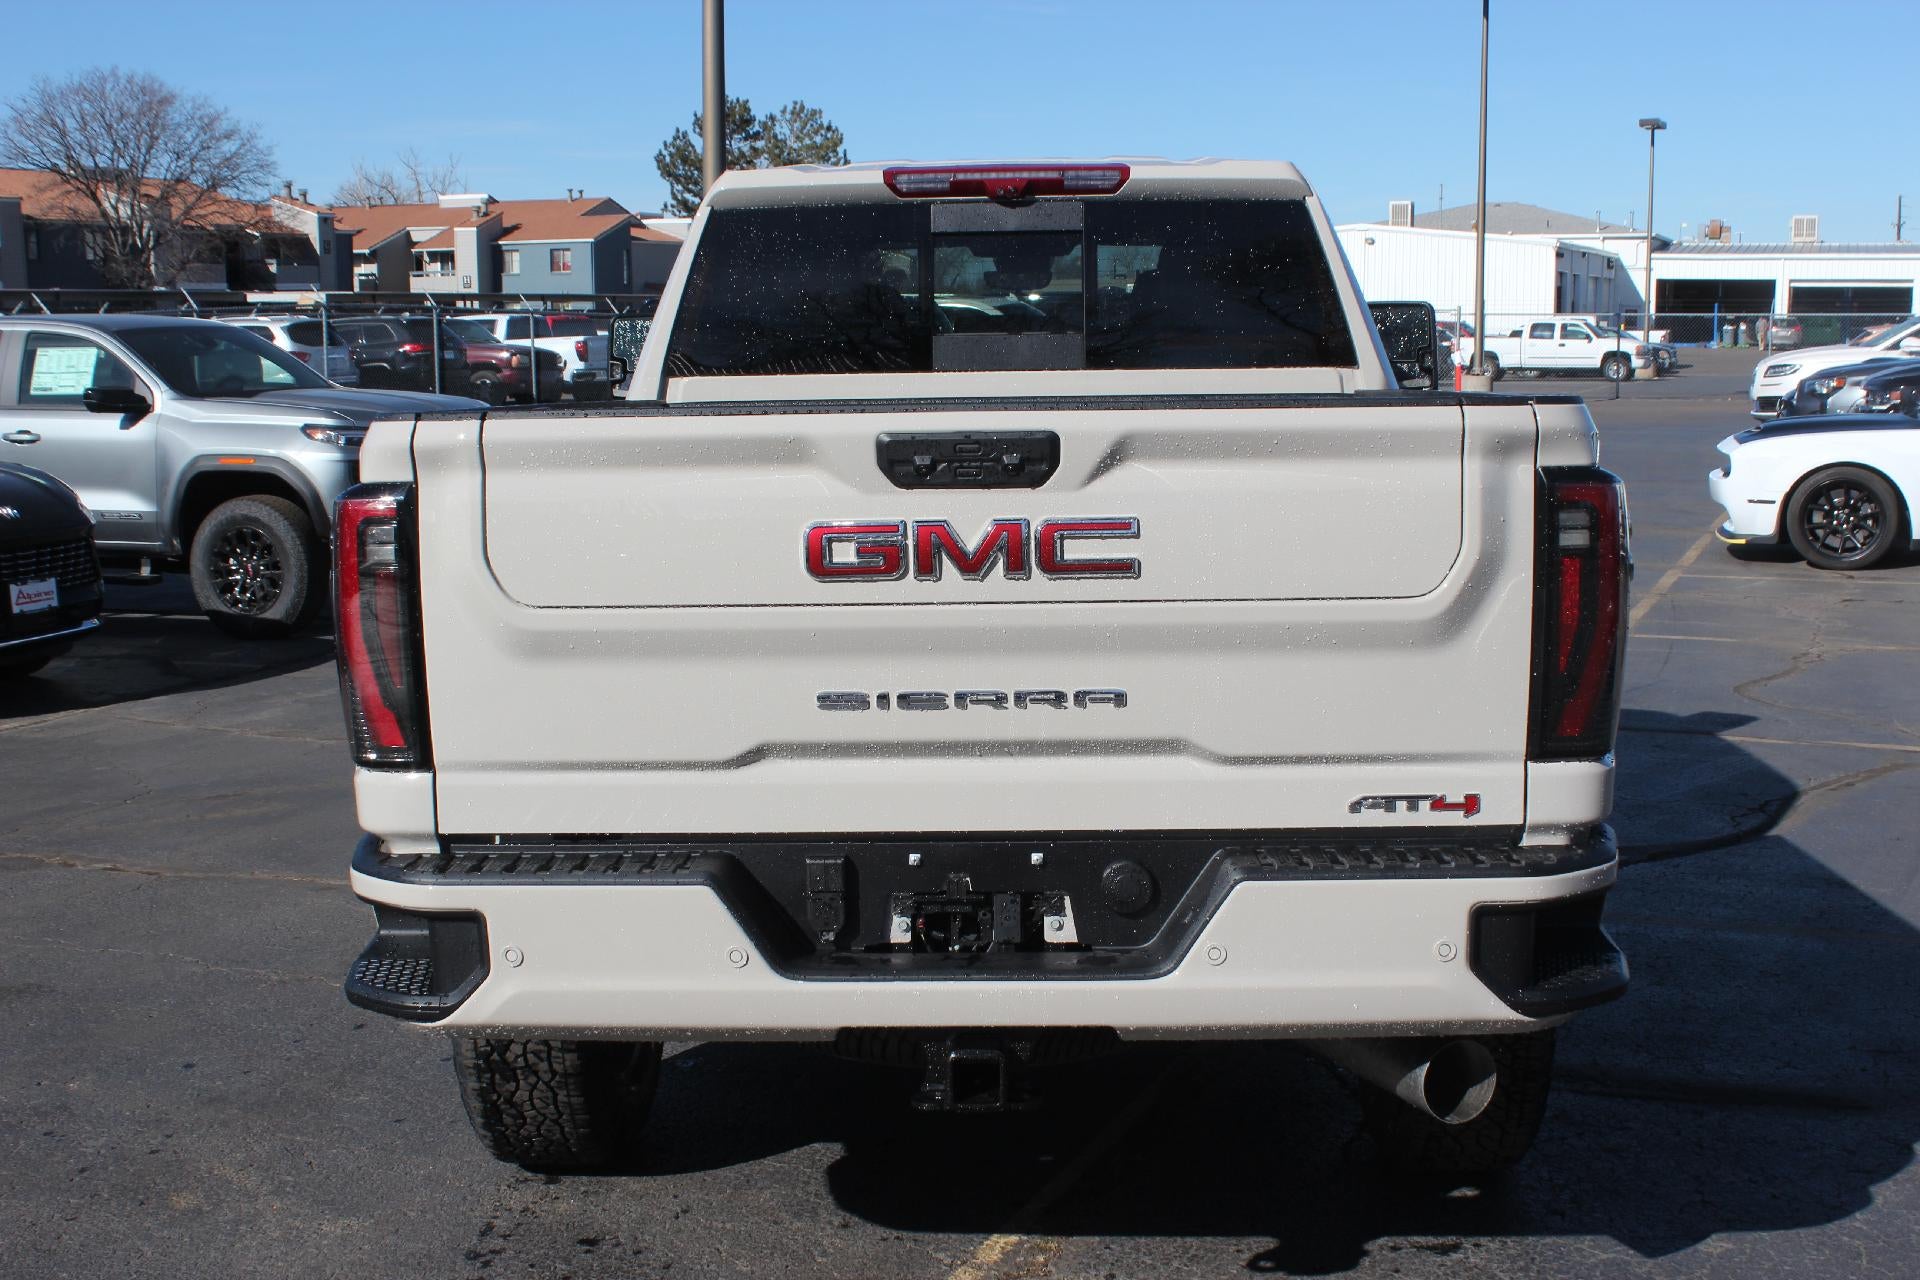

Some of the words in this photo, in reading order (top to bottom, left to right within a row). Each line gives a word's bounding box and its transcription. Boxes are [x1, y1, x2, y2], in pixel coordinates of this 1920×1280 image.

[804, 517, 1141, 582] GMC
[816, 689, 1128, 711] SIERRA
[1348, 793, 1481, 818] AT4
